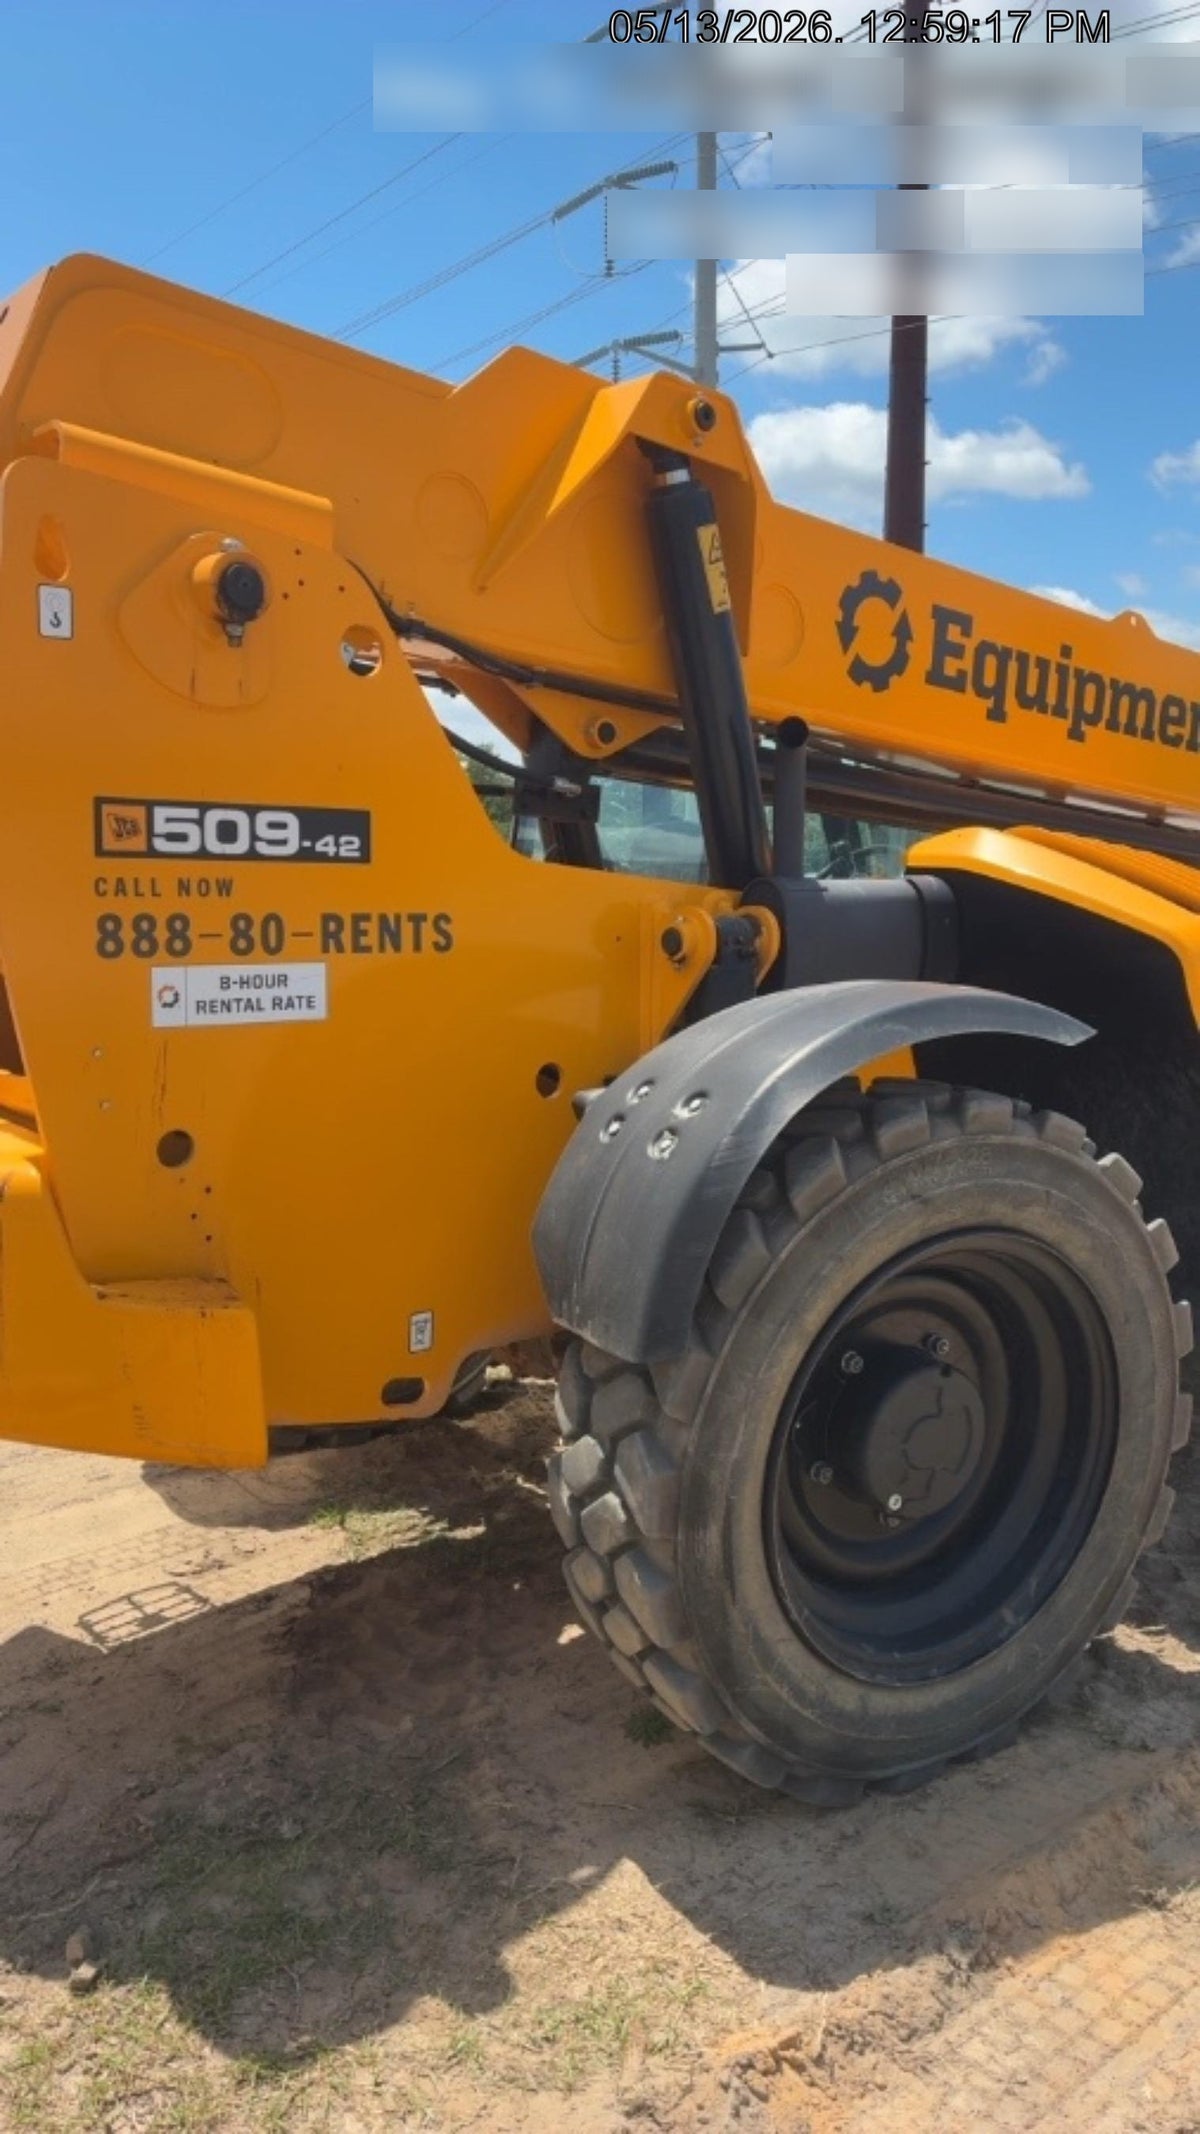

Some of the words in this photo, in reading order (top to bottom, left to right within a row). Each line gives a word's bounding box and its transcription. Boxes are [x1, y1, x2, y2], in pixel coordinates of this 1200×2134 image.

[94, 876, 163, 898] CALL
[177, 876, 234, 898] NOW
[196, 997, 265, 1015] RENTAL
[271, 995, 317, 1011] RATE
